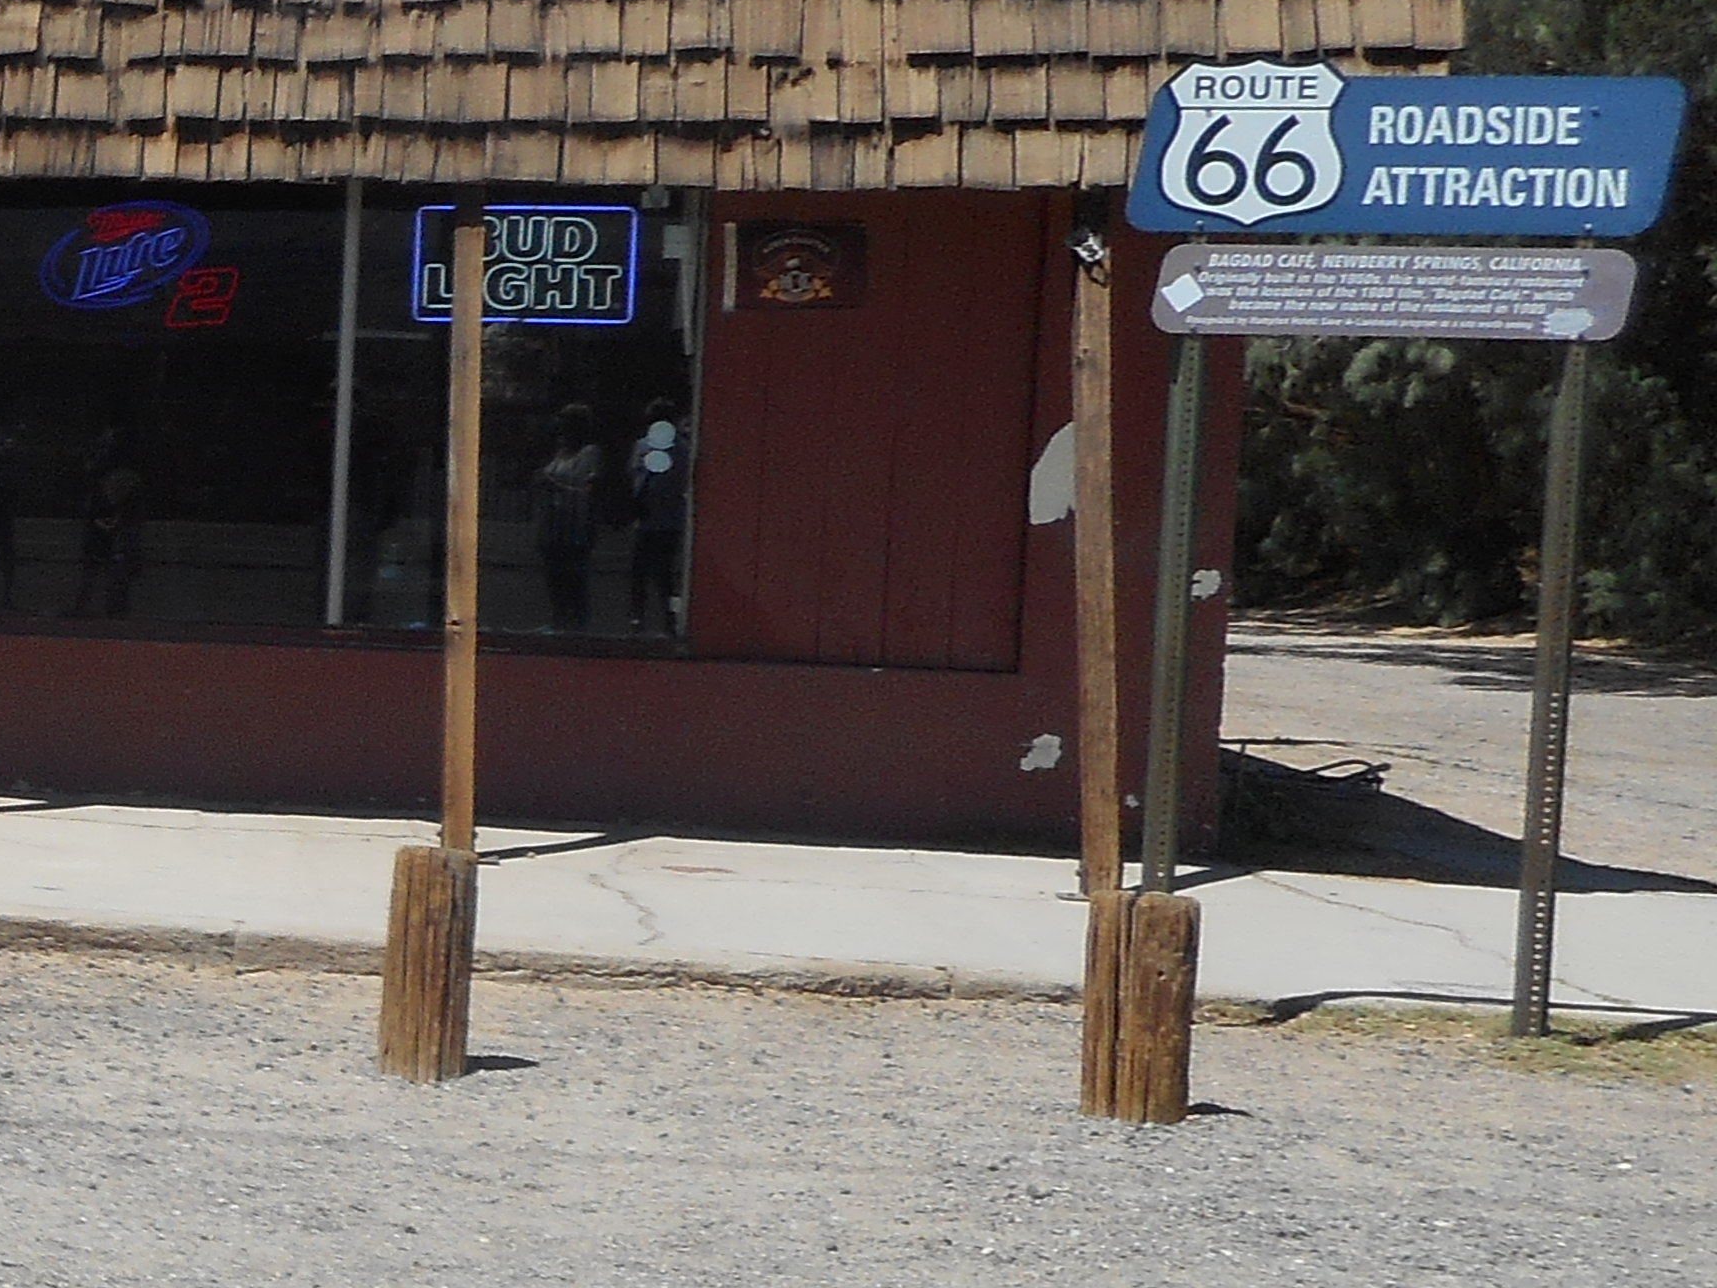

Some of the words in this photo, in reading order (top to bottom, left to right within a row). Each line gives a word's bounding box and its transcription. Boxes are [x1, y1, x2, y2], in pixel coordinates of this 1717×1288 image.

[1193, 75, 1319, 100] ROUTE
[1369, 106, 1582, 145] ROADSIDE
[1185, 114, 1316, 207] 66
[1361, 166, 1629, 208] ATTRACTION
[72, 226, 188, 301] Lite
[1208, 253, 1273, 268] BAGDAD
[1322, 254, 1408, 270] NEWBERRY
[422, 263, 623, 311] LGHT
